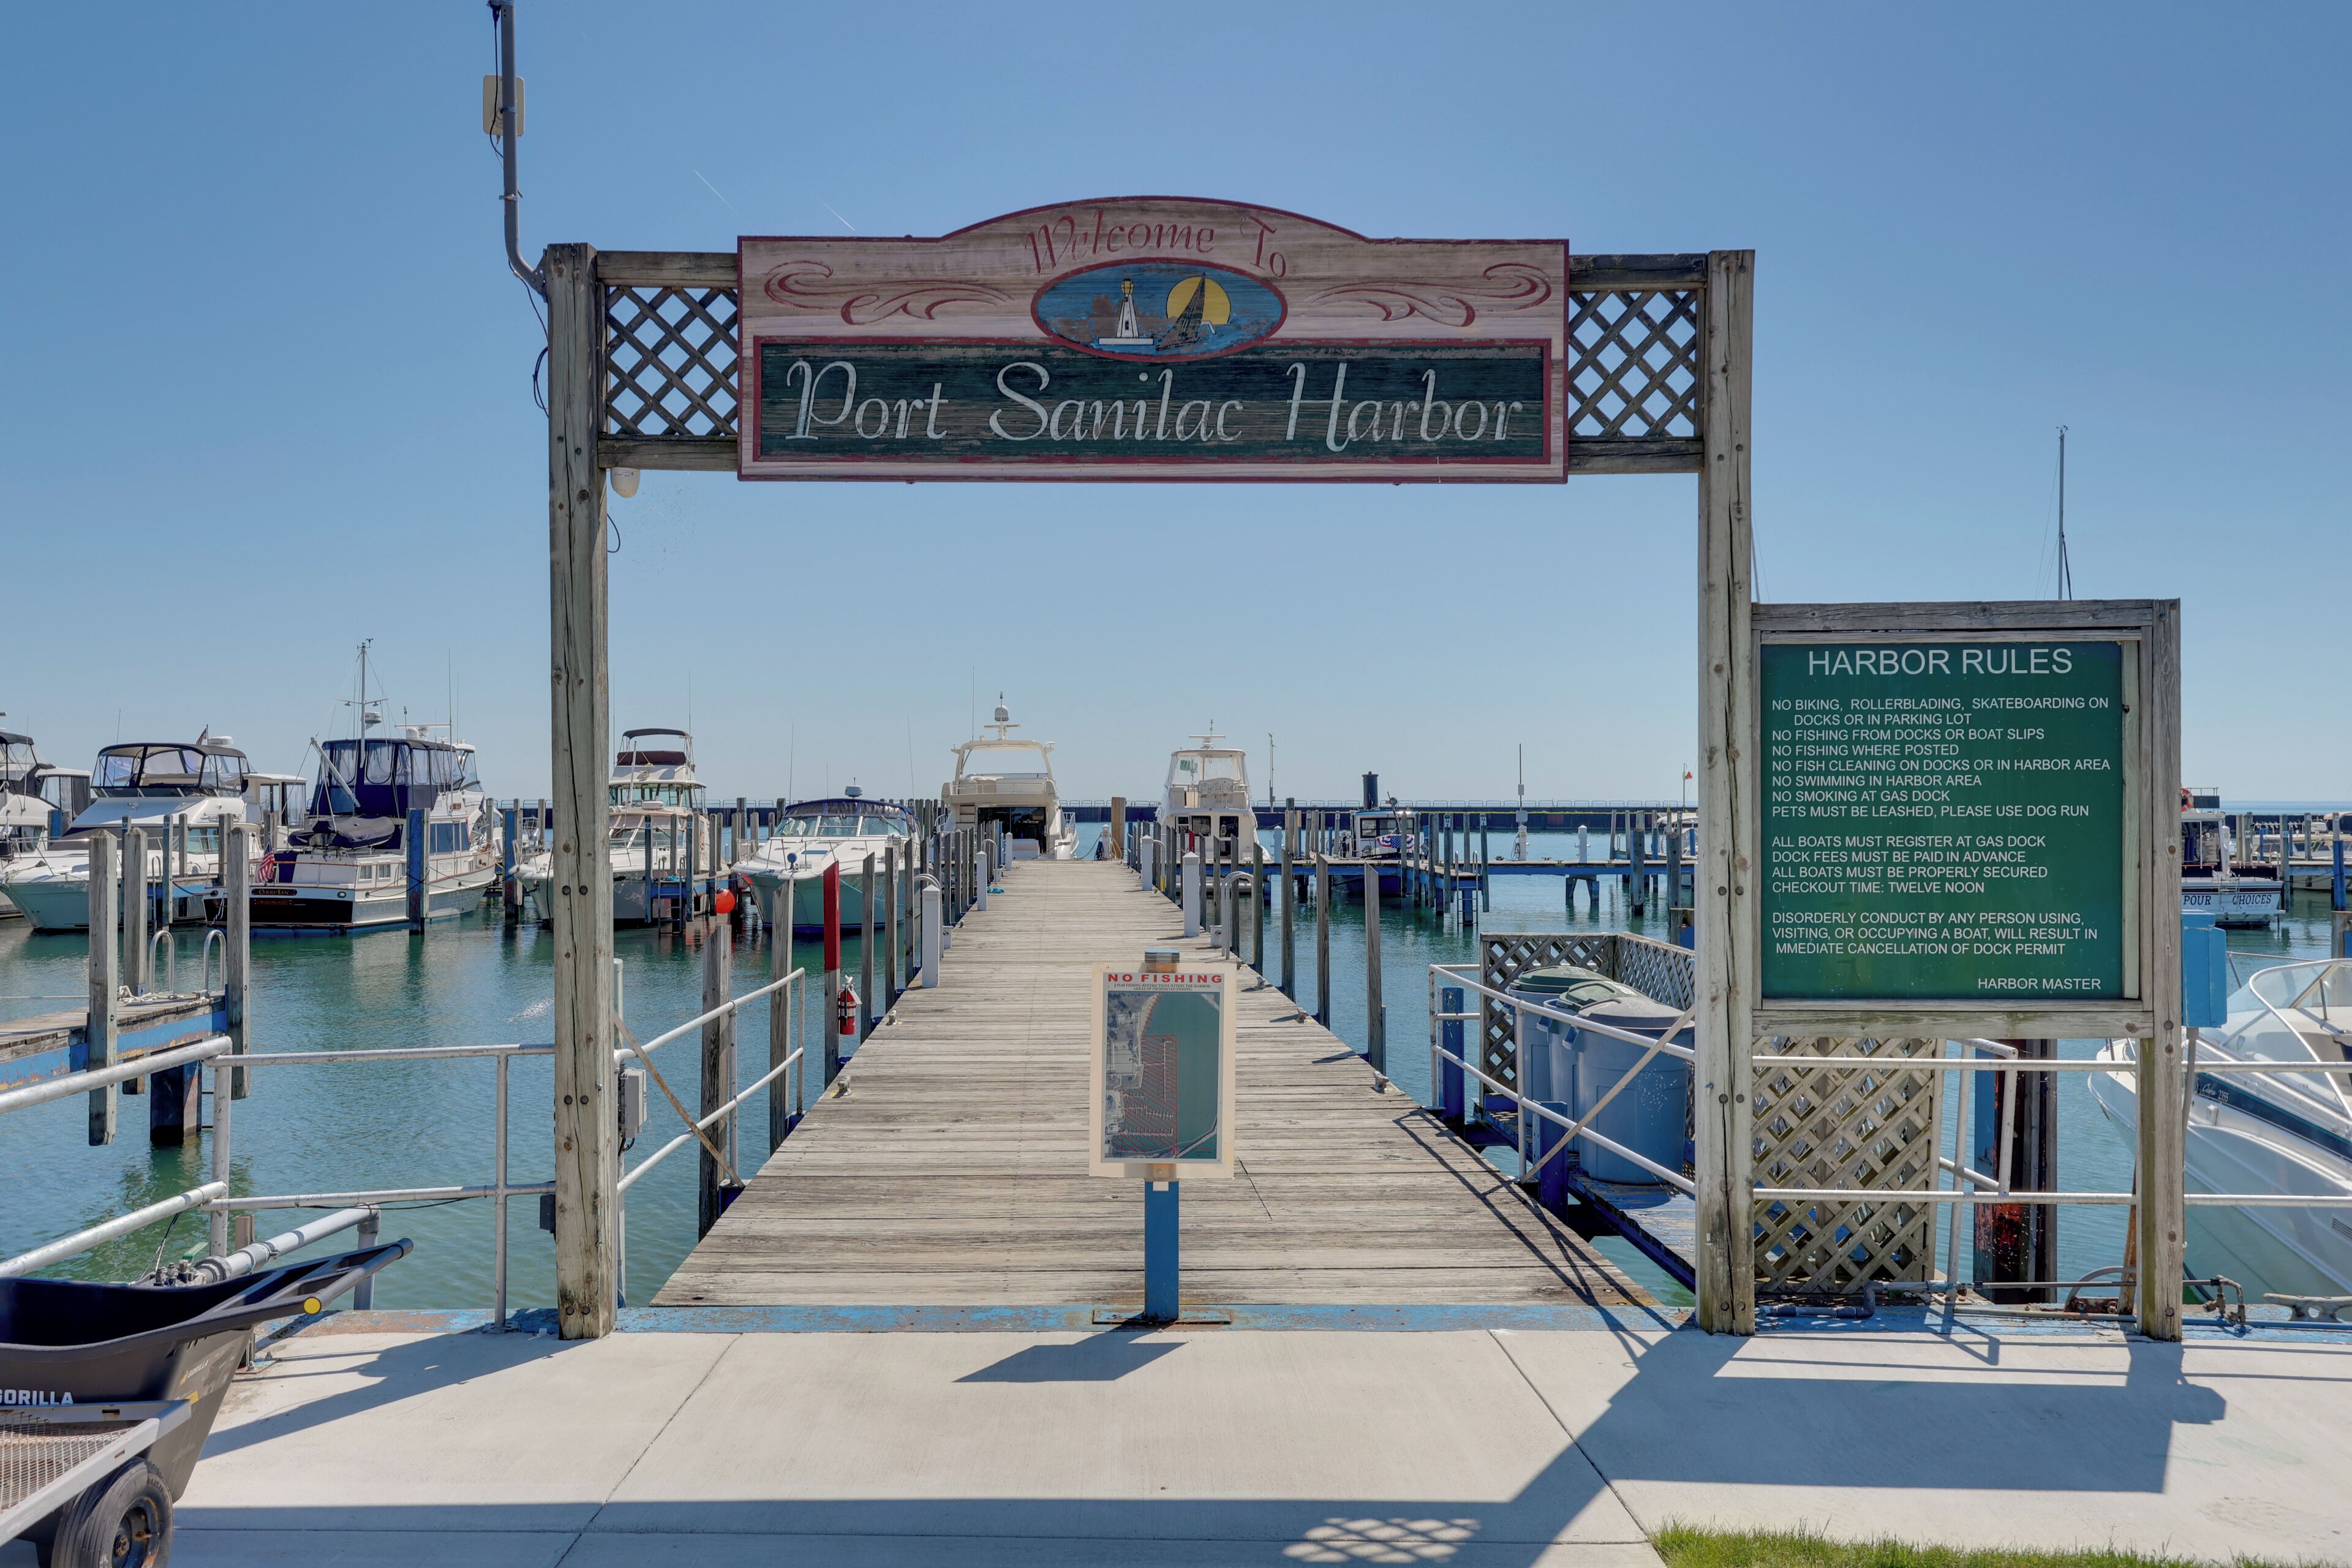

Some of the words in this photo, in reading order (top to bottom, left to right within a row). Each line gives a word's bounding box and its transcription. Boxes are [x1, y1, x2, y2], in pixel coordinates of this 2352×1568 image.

[1025, 209, 1215, 277] Welcome
[1239, 216, 1287, 278] To
[785, 361, 950, 440] Port
[989, 361, 1244, 442] Sanilac
[1286, 362, 1524, 452] Harbor
[1809, 649, 1951, 676] HARBOR
[1962, 648, 2073, 674] RULES
[1772, 699, 1792, 710] NO
[1795, 699, 1843, 712] BIKING,
[1850, 698, 1964, 711] ROLLERBLADING,
[1972, 697, 2085, 709] SKATEBOARDING
[2089, 697, 2108, 709] ON
[1794, 714, 1841, 726] DOCKS
[1844, 714, 1864, 725] OR
[1868, 714, 1880, 725] IN
[1884, 713, 1942, 725] PARKING
[1946, 713, 1972, 725] LOT
[1772, 729, 1792, 741] NO
[1795, 729, 1849, 741] FISHING
[1852, 729, 1891, 741] FROM
[1894, 728, 1941, 741] DOCKS
[1945, 728, 1965, 740] OR
[1968, 728, 2004, 740] BOAT
[2007, 728, 2045, 740] SLIPS
[1772, 745, 1792, 756] NO
[1795, 744, 1849, 756] FISHING
[1852, 744, 1901, 756] WHERE
[1905, 744, 1959, 756] POSTED
[1772, 760, 1792, 772] NO
[1795, 760, 1825, 772] FISH
[1828, 760, 1896, 771] CLEANING
[1899, 760, 1919, 771] ON
[1923, 759, 1970, 771] DOCKS
[1973, 759, 1994, 771] OR
[1997, 759, 2010, 771] IN
[2014, 759, 2071, 771] HARBOR
[2073, 758, 2111, 771] AREA
[1772, 775, 1792, 787] NO
[1795, 775, 1866, 786] SWIMMING
[1869, 775, 1882, 786] IN
[1886, 775, 1942, 786] HARBOR
[1945, 774, 1982, 786] AREA
[1772, 791, 1792, 802] NO
[1795, 790, 1857, 802] SMOKING
[1860, 790, 1877, 802] AT
[1880, 790, 1909, 802] GAS
[1912, 790, 1950, 802] DOCK
[1772, 805, 1806, 817] PETS
[1810, 805, 1848, 817] MUST
[1851, 805, 1869, 817] BE
[1872, 805, 1937, 818] LEASHED,
[1941, 805, 1992, 817] PLEASE
[1996, 805, 2023, 817] USE
[2027, 805, 2057, 816] DOG
[2060, 805, 2089, 816] RUN
[1771, 836, 1795, 847] ALL
[1798, 835, 1842, 847] BOATS
[1845, 835, 1883, 847] MUST
[1886, 835, 1953, 847] REGISTER
[1956, 835, 1973, 847] AT
[1975, 835, 2004, 847] GAS
[2007, 835, 2046, 847] DOCK
[1772, 851, 1811, 862] DOCK
[1814, 851, 1848, 862] FEES
[1852, 851, 1889, 862] MUST
[1893, 851, 1910, 862] BE
[1914, 851, 1943, 862] PAID
[1947, 851, 1959, 862] IN
[1962, 851, 2026, 862] ADVANCE
[1771, 867, 1796, 878] ALL
[1799, 866, 1842, 878] BOATS
[1846, 866, 1884, 878] MUST
[1887, 866, 1905, 878] BE
[1909, 866, 1980, 878] PROPERLY
[1983, 866, 2048, 878] SECURED
[1772, 881, 1846, 893] CHECKOUT
[1849, 881, 1883, 893] TIME:
[1888, 881, 1942, 893] TWELVE
[1945, 881, 1985, 893] NOON
[2183, 895, 2212, 905] POUR
[2232, 894, 2272, 905] CHOICES
[1773, 912, 1857, 924] DISORDERLY
[1860, 912, 1926, 924] CONDUCT
[1928, 912, 1945, 924] BY
[1948, 912, 1976, 924] ANY
[1979, 912, 2035, 924] PERSON
[2039, 912, 2084, 926] USING,
[1772, 927, 1831, 941] VISITING,
[1834, 927, 1855, 939] OR
[1858, 927, 1938, 939] OCCUPYING
[1940, 927, 1951, 939] A
[1954, 927, 1991, 941] BOAT,
[1994, 928, 2026, 940] WILL
[2029, 928, 2081, 940] RESULT
[2084, 928, 2098, 940] IN
[1776, 942, 1844, 954] MMEDIATE
[1847, 943, 1948, 954] CANCELLATION
[1951, 943, 1970, 954] OF
[1973, 943, 2012, 955] DOCK
[2015, 943, 2066, 955] PERMIT
[1108, 974, 1133, 982] NO
[1141, 974, 1223, 984] FISHING
[1978, 978, 2038, 990] HARBOR
[2042, 978, 2101, 990] MASTER
[0, 1389, 74, 1406] ORILLA
